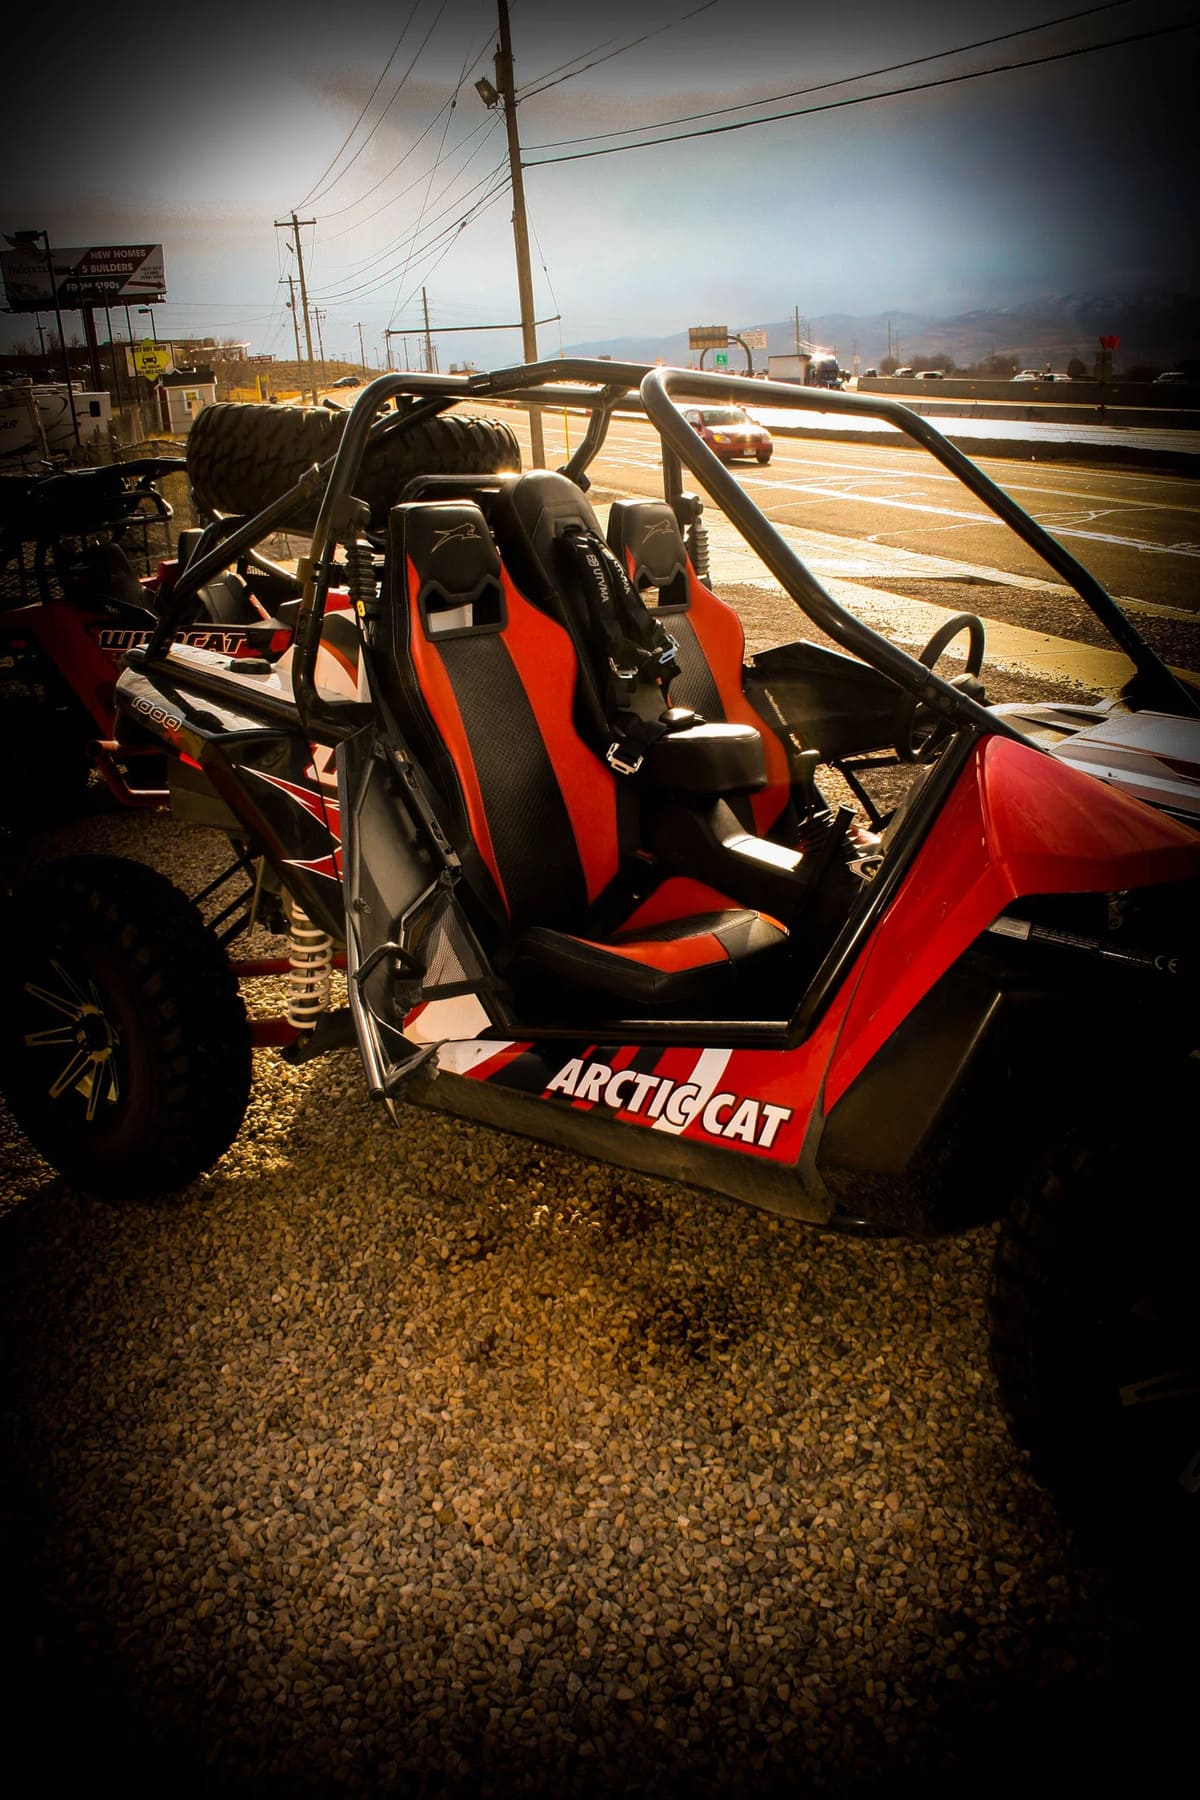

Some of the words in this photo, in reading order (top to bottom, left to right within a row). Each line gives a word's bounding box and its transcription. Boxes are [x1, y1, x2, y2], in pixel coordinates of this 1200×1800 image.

[90, 250, 110, 259] NEW
[112, 249, 146, 258] HOMES
[90, 263, 134, 272] BUILDERS
[98, 629, 247, 654] WICAT
[131, 696, 182, 732] 1000
[545, 1057, 702, 1127] ARCTIC
[702, 1093, 792, 1148] CAT
